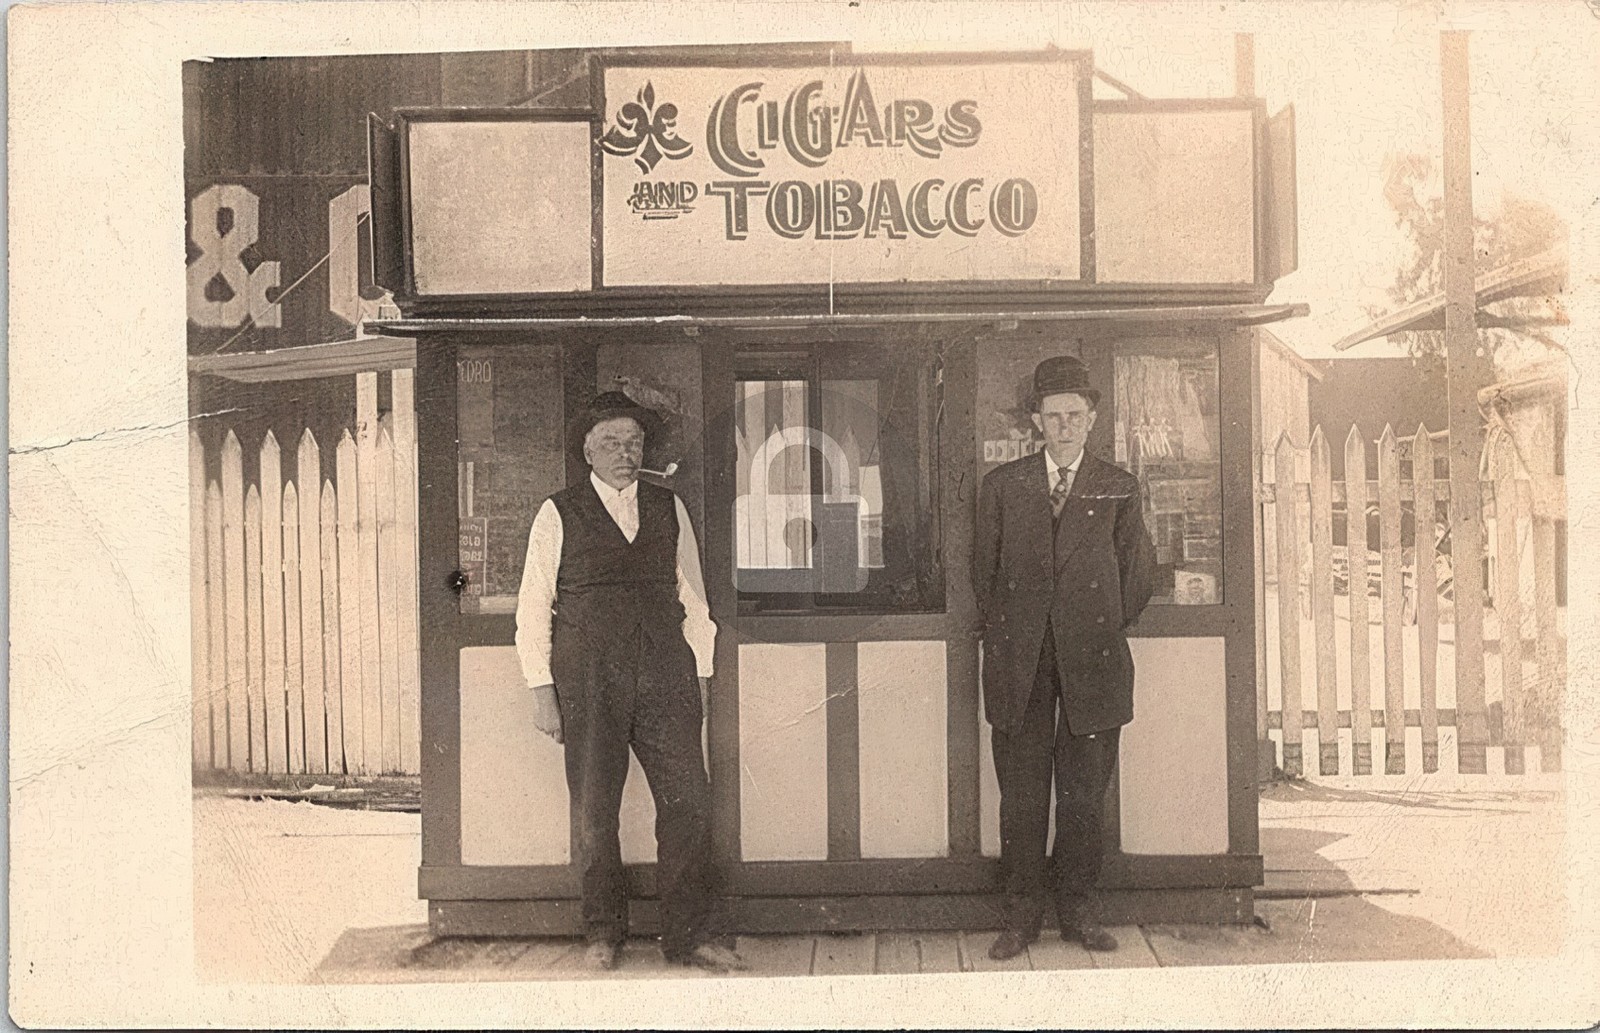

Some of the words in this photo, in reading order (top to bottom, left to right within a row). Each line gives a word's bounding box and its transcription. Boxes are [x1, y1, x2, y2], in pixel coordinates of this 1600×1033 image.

[706, 67, 982, 177] CIGARS
[186, 184, 281, 329] &
[627, 181, 699, 211] AND
[704, 178, 1038, 241] TOBACCO
